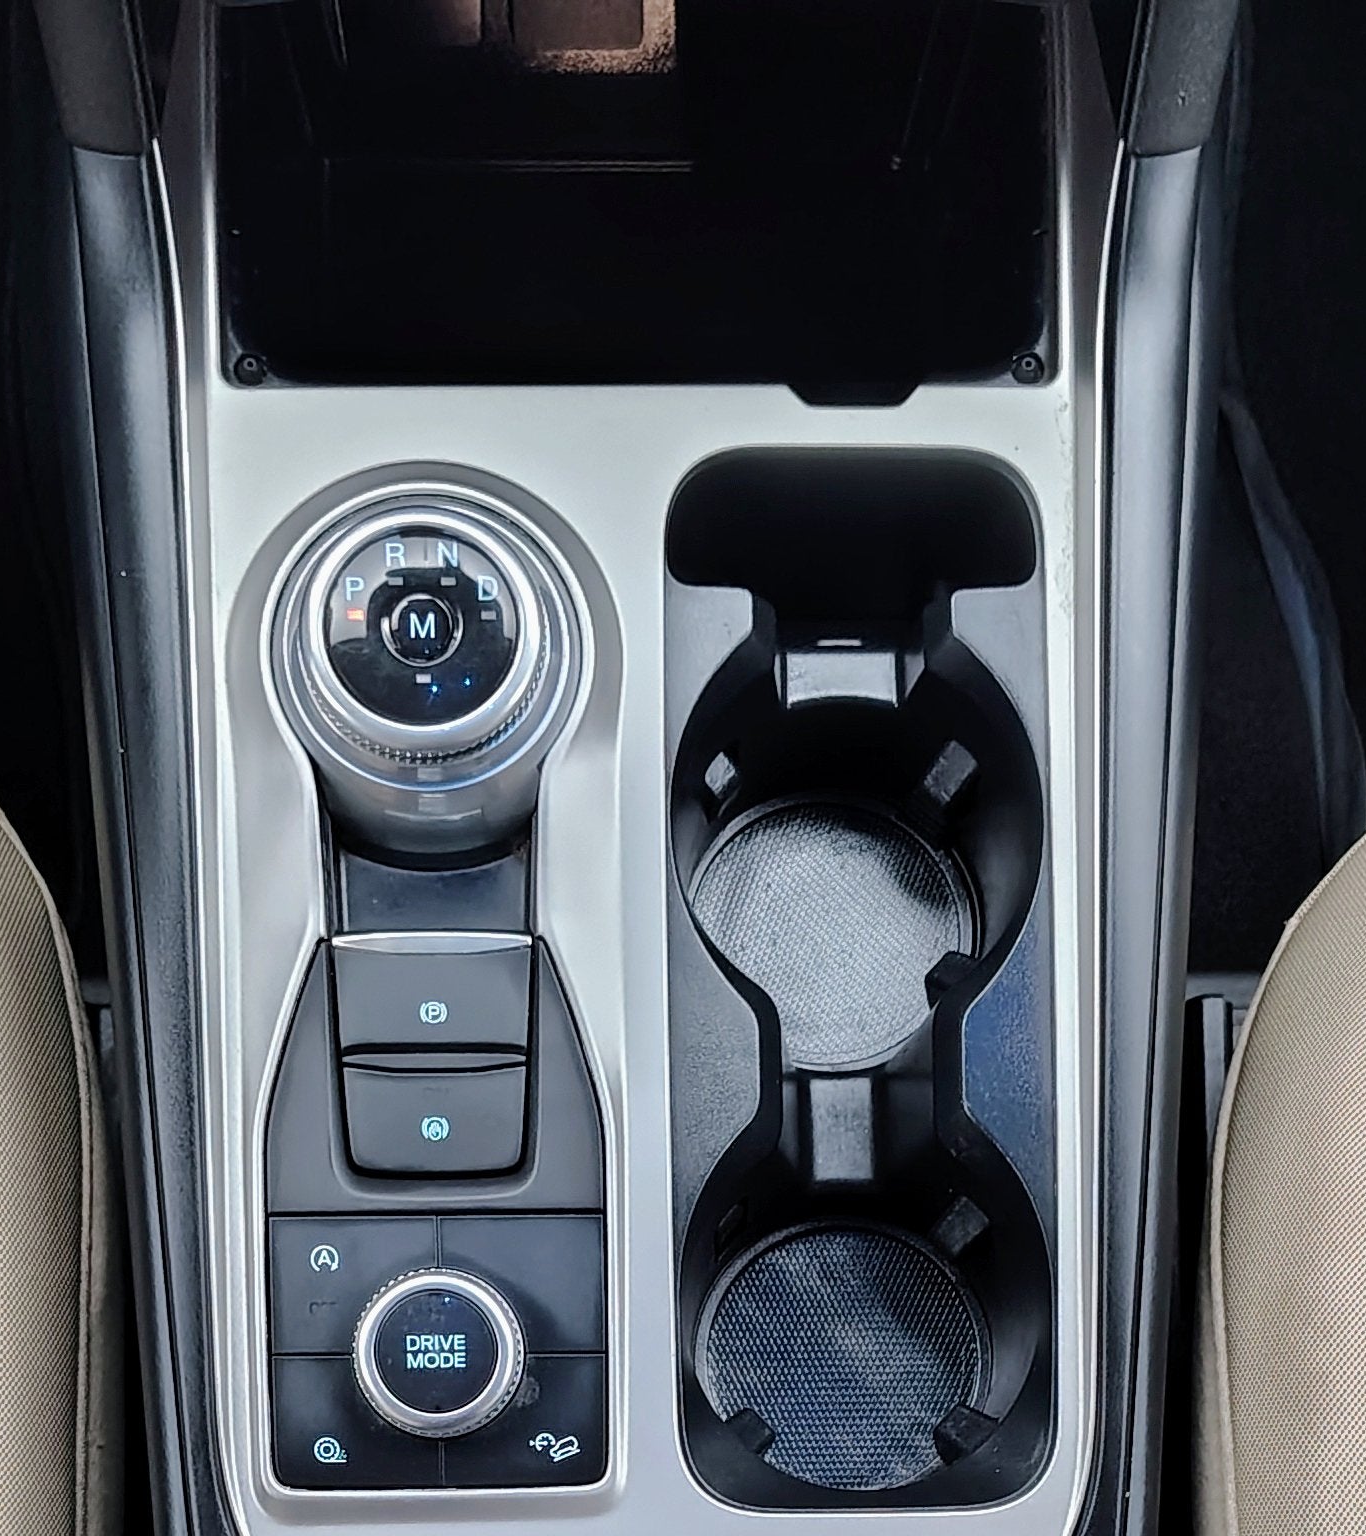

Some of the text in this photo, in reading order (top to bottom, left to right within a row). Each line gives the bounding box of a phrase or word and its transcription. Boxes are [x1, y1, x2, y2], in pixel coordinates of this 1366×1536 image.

[346, 542, 499, 601] P R N D
[410, 612, 436, 639] M
[406, 1334, 466, 1351] DRIVE
[406, 1352, 467, 1369] MODE
